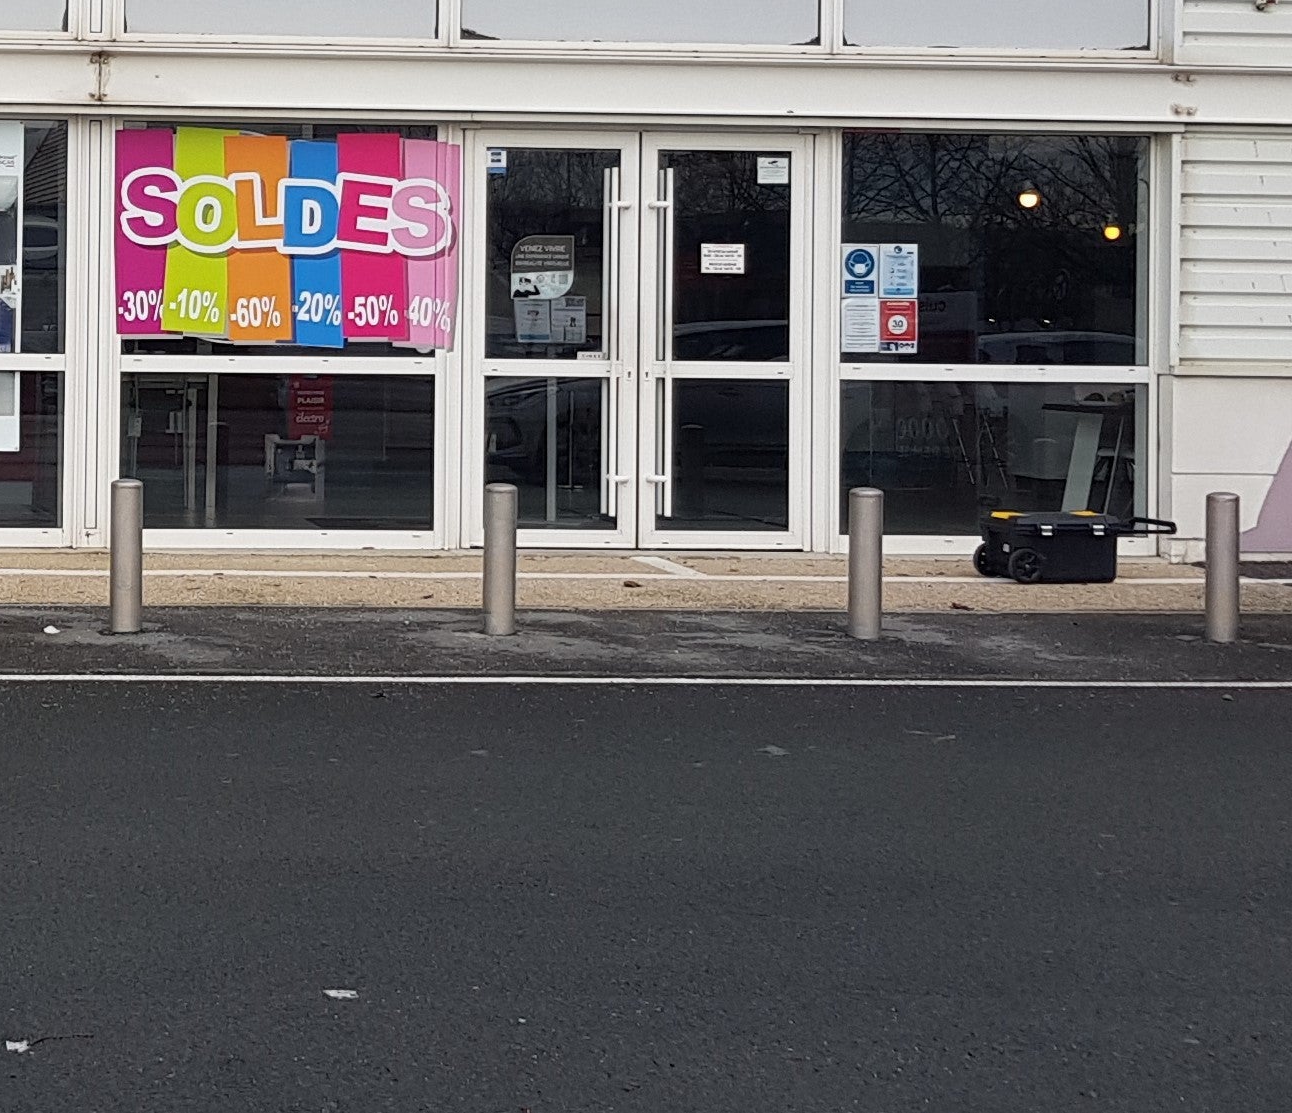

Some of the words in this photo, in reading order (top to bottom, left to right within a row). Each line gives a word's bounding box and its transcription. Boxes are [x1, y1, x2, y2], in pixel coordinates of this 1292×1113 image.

[120, 166, 453, 256] SOLDES
[118, 289, 164, 322] -30%
[169, 288, 220, 323] -10%
[230, 291, 281, 328] -60%
[292, 290, 342, 326] -20%
[347, 294, 399, 327] -50%
